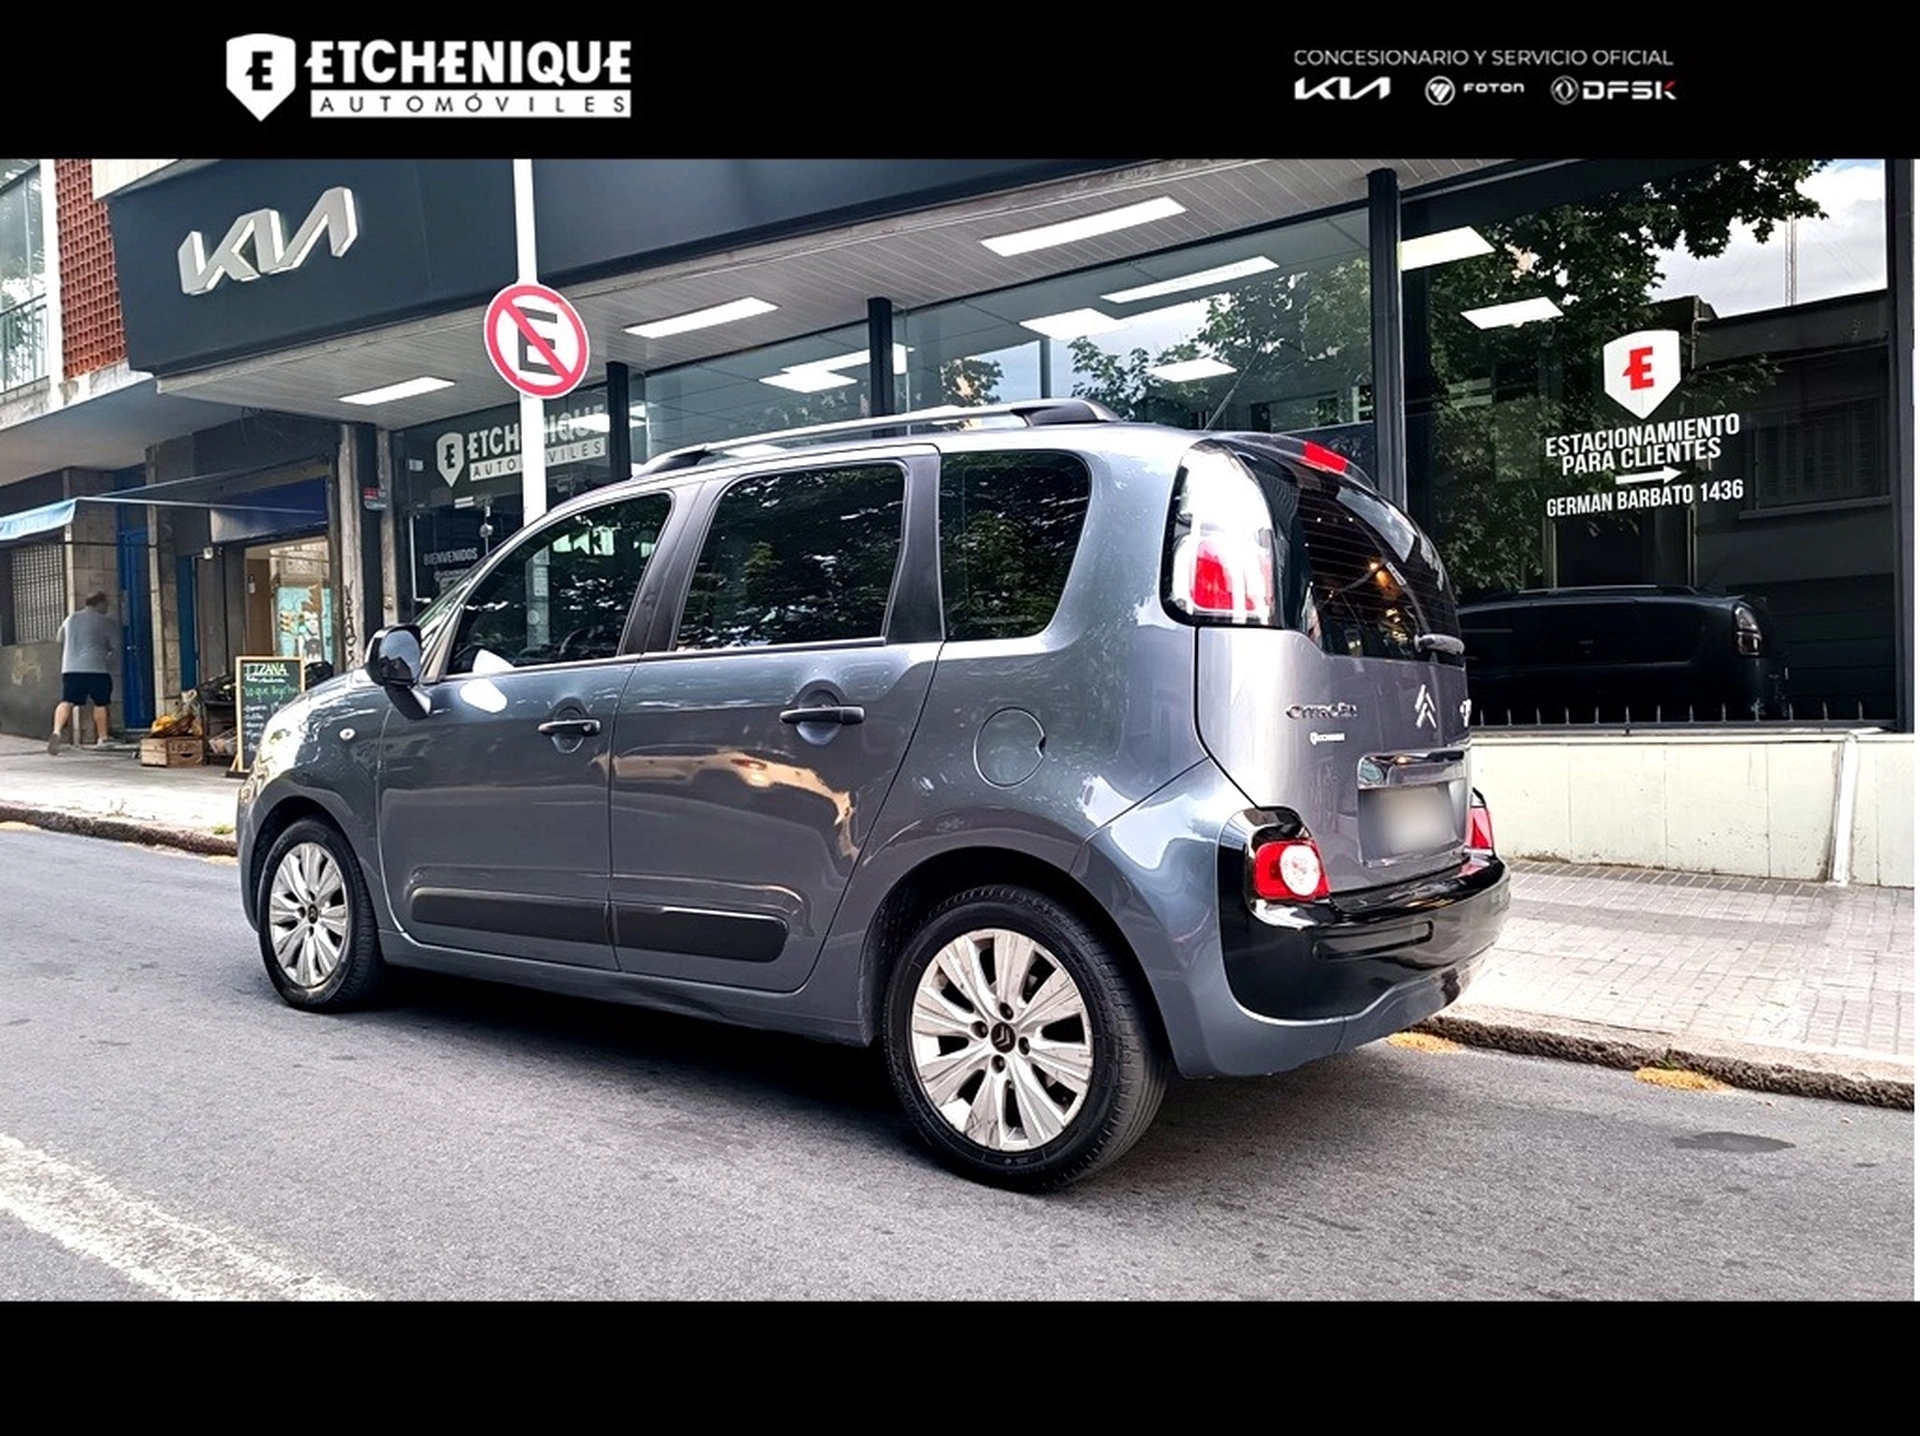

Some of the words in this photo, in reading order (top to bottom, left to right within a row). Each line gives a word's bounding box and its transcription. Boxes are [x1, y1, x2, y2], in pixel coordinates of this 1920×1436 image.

[177, 186, 358, 295] KIA
[517, 305, 559, 377] E
[1621, 345, 1655, 391] E
[1545, 412, 1741, 458] ESTACIONAMIENTO
[1562, 449, 1616, 476] PARA
[1620, 437, 1722, 469] CLIENTES
[473, 440, 601, 478] AUTOVILES
[1546, 492, 1613, 518] GERMAN
[1616, 484, 1694, 511] BARBATO
[1701, 479, 1744, 502] 1436
